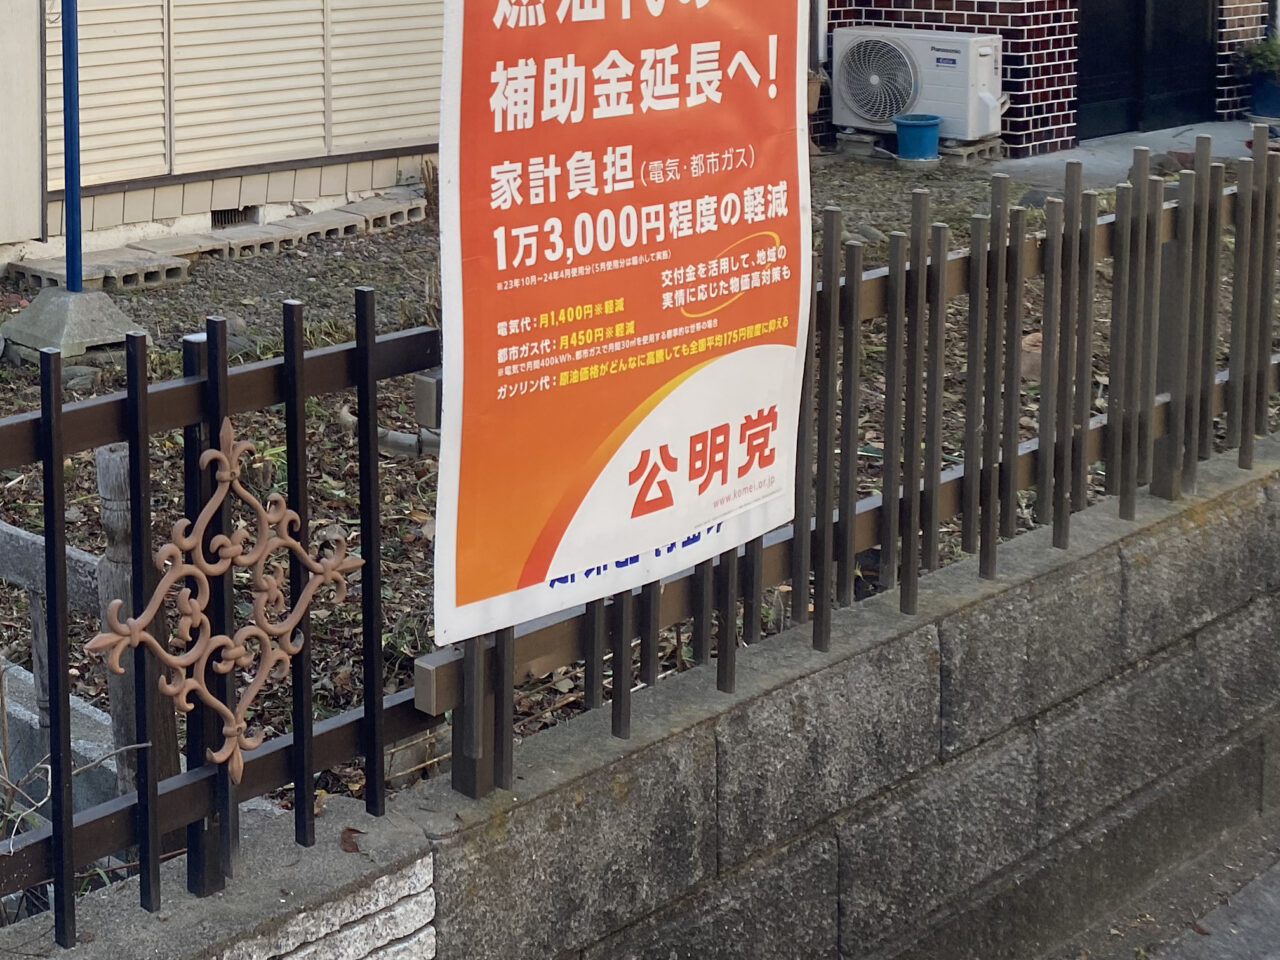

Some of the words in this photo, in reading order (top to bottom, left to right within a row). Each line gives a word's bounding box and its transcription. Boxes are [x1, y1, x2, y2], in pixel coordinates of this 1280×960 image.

[489, 34, 778, 132] 補助金延長へ！
[492, 180, 789, 271] 1万3,000円程度の軽減
[661, 245, 787, 287] 交付金を活用して、地域の
[662, 265, 791, 310] 実情に応じた物価高対策も
[628, 404, 778, 519] 公明党
[713, 475, 776, 508] www.komei.or.jp
